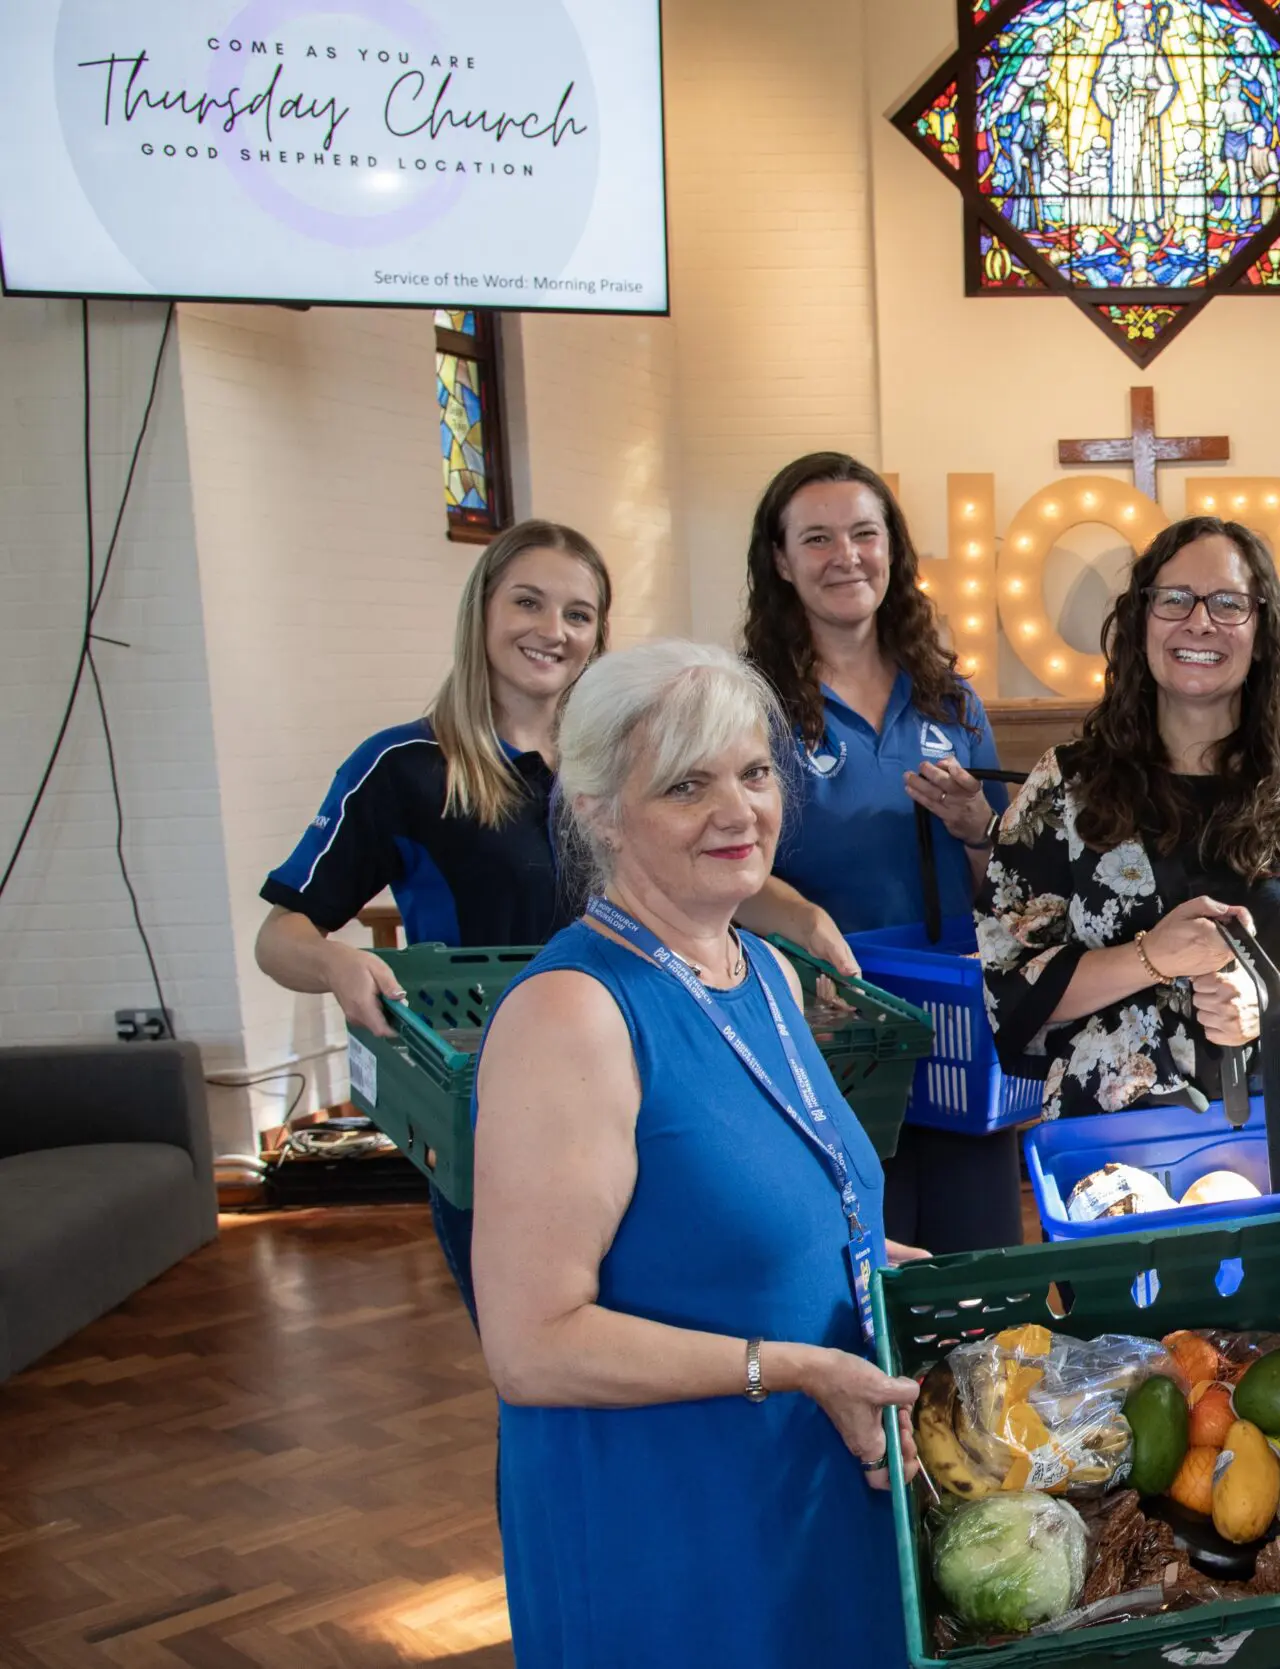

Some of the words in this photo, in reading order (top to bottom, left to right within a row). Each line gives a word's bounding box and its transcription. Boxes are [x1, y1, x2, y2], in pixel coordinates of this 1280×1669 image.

[207, 37, 284, 55] COME
[306, 45, 337, 60] AS
[358, 48, 409, 64] YOU
[430, 54, 475, 69] ARE
[77, 49, 350, 151] Thursday
[384, 70, 588, 147] Church
[141, 143, 218, 159] GOOD
[240, 148, 378, 168] SHEPHERD
[398, 157, 533, 176] LOCATION
[374, 270, 430, 286] Service
[434, 272, 450, 287] of
[453, 273, 479, 288] the
[483, 274, 529, 289] Word:
[533, 276, 596, 295] Morning
[600, 279, 643, 293] Praise
[610, 908, 640, 932] CHURCH
[667, 961, 703, 999] HOUNSLOW
[671, 957, 690, 977] HOPE
[688, 975, 713, 1005] CHURCH
[801, 1088, 813, 1109] HOPE
